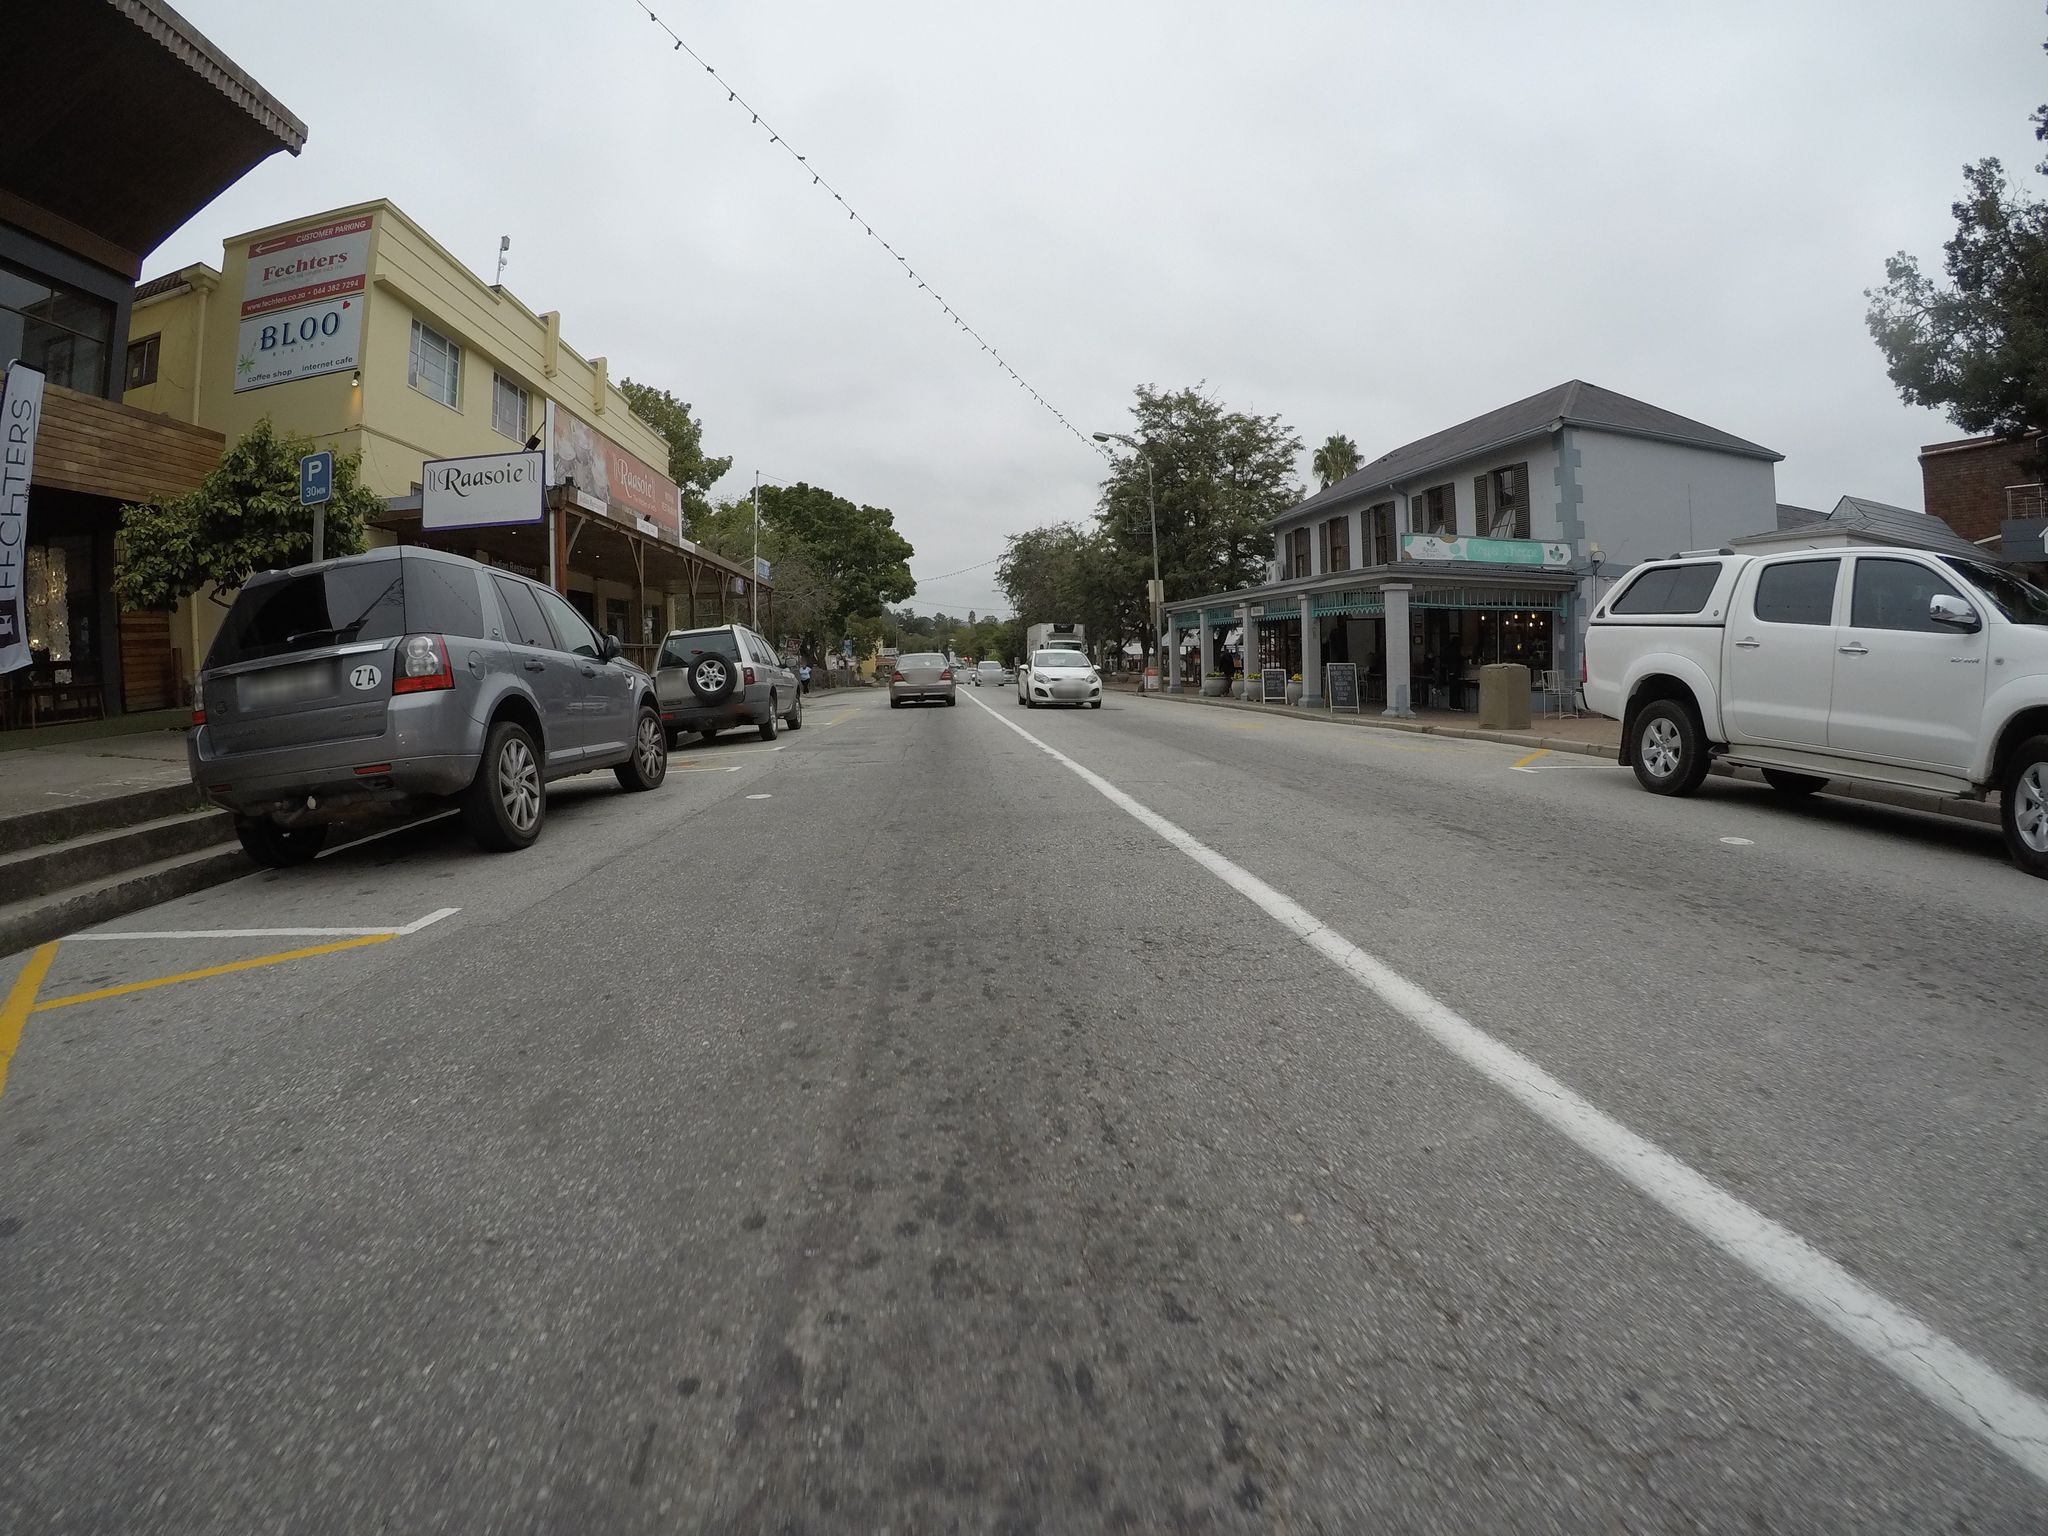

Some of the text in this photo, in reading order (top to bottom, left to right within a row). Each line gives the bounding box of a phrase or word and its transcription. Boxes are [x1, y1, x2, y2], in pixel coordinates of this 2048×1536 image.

[296, 220, 367, 243] CUSTOMER PARKING
[262, 252, 349, 282] Fechters
[312, 286, 326, 296] 044
[326, 283, 341, 292] 382
[341, 279, 359, 290] 7294
[260, 311, 339, 351] BLOO
[247, 356, 353, 383] coffee shop internet cafe
[307, 460, 323, 482] P
[437, 462, 523, 497] Raasoie
[617, 458, 652, 499] Raasoie
[354, 667, 378, 687] ZA
